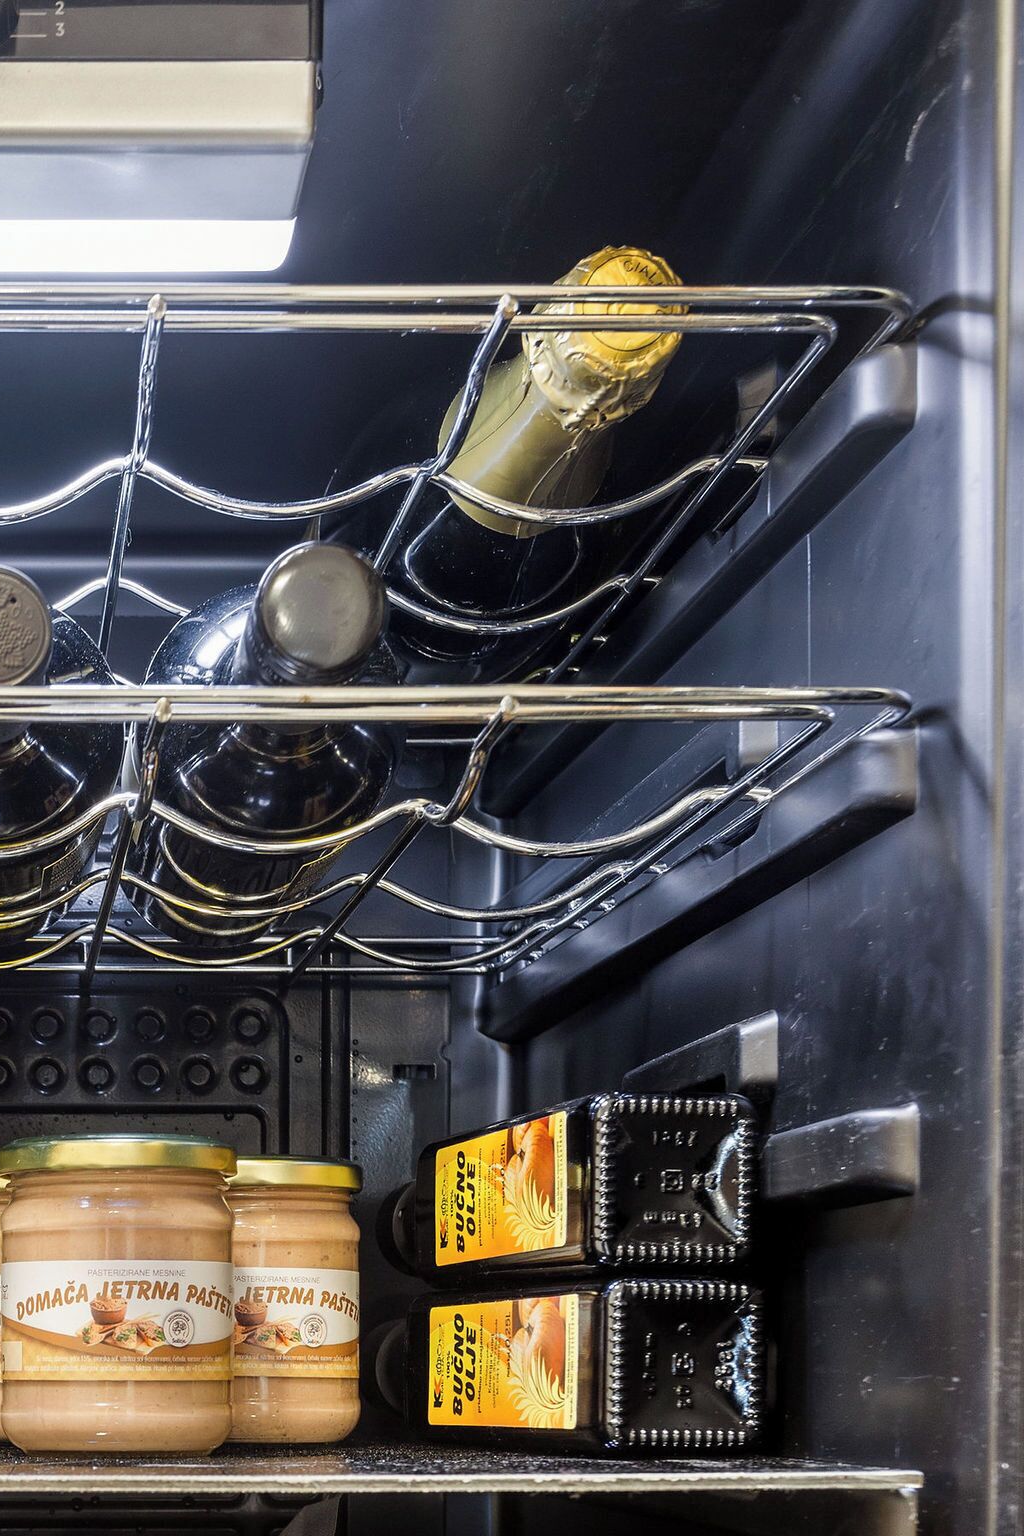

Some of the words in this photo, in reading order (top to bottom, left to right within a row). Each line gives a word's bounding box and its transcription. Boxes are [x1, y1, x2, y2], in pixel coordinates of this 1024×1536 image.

[55, 1, 65, 16] 2
[55, 22, 65, 37] 3
[454, 1150, 466, 1253] BUČNO
[466, 1162, 476, 1237] OLJE
[88, 1269, 150, 1277] PASTERIZIRANE
[16, 1280, 89, 1321] DOMAČA
[96, 1280, 180, 1301] JETRNA
[239, 1285, 315, 1306] JETRNA
[451, 1313, 464, 1416] BUČNO
[465, 1327, 477, 1402] OLJE
